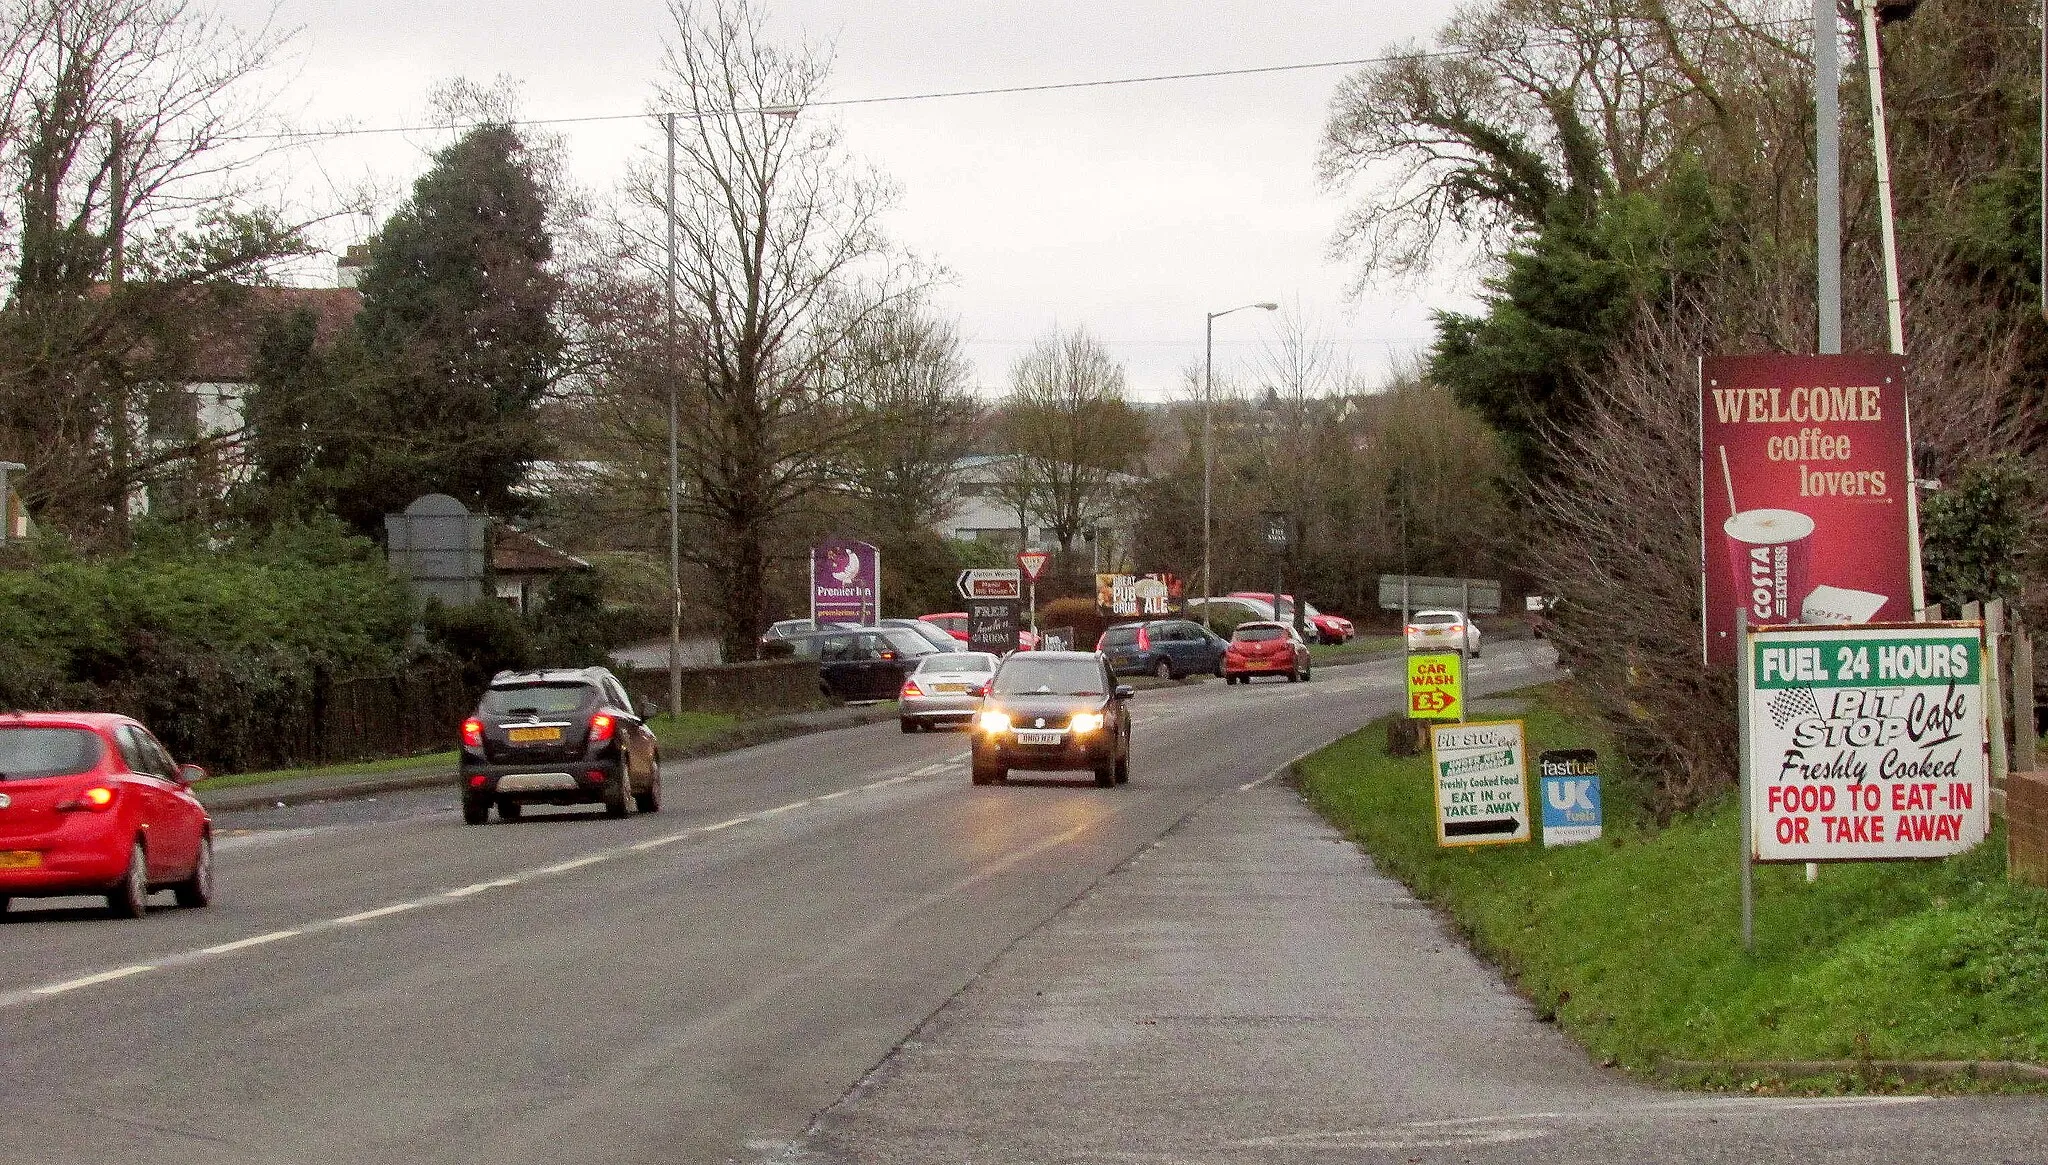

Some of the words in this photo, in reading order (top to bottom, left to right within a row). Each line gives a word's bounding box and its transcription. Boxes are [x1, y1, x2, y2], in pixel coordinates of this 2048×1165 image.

[1712, 386, 1882, 424] WELCOME
[1767, 427, 1851, 461] coffee
[1800, 464, 1887, 497] lovers
[1113, 576, 1136, 586] GREAT
[1775, 546, 1788, 599] EXPRESS
[817, 586, 855, 597] Premier
[1751, 547, 1774, 619] COSTA
[1113, 586, 1136, 602] PUB
[818, 609, 871, 618] premierinn.cm
[974, 606, 1009, 618] FREE
[1113, 602, 1137, 614] GRUB
[1144, 597, 1169, 614] ALE
[1417, 664, 1447, 675] CAR
[1762, 647, 1828, 682] FUEL
[1837, 646, 1870, 681] 24
[1878, 644, 1969, 680] HOURS
[1412, 675, 1455, 686] WASH
[1418, 692, 1446, 709] £5
[1832, 688, 1905, 719] PIT
[1437, 733, 1460, 748] PIT
[1463, 731, 1499, 746] STOP
[1793, 717, 1908, 748] STOP
[1540, 759, 1598, 776] fastfuel
[1779, 749, 1868, 784] Freshly
[1879, 748, 1962, 780] Cooked
[1440, 777, 1468, 790] Freshly
[1470, 775, 1500, 788] Cooked
[1500, 774, 1519, 786] Food
[1451, 790, 1476, 803] EAT
[1481, 789, 1494, 801] IN
[1499, 791, 1512, 801] or
[1547, 780, 1595, 810] UK
[1768, 785, 1836, 813] FOOD
[1847, 784, 1881, 811] TO
[1892, 783, 1973, 811] EAT-IN
[1776, 816, 1810, 844] OR
[1822, 815, 1885, 843] TAKE
[1895, 814, 1964, 842] AWAY
